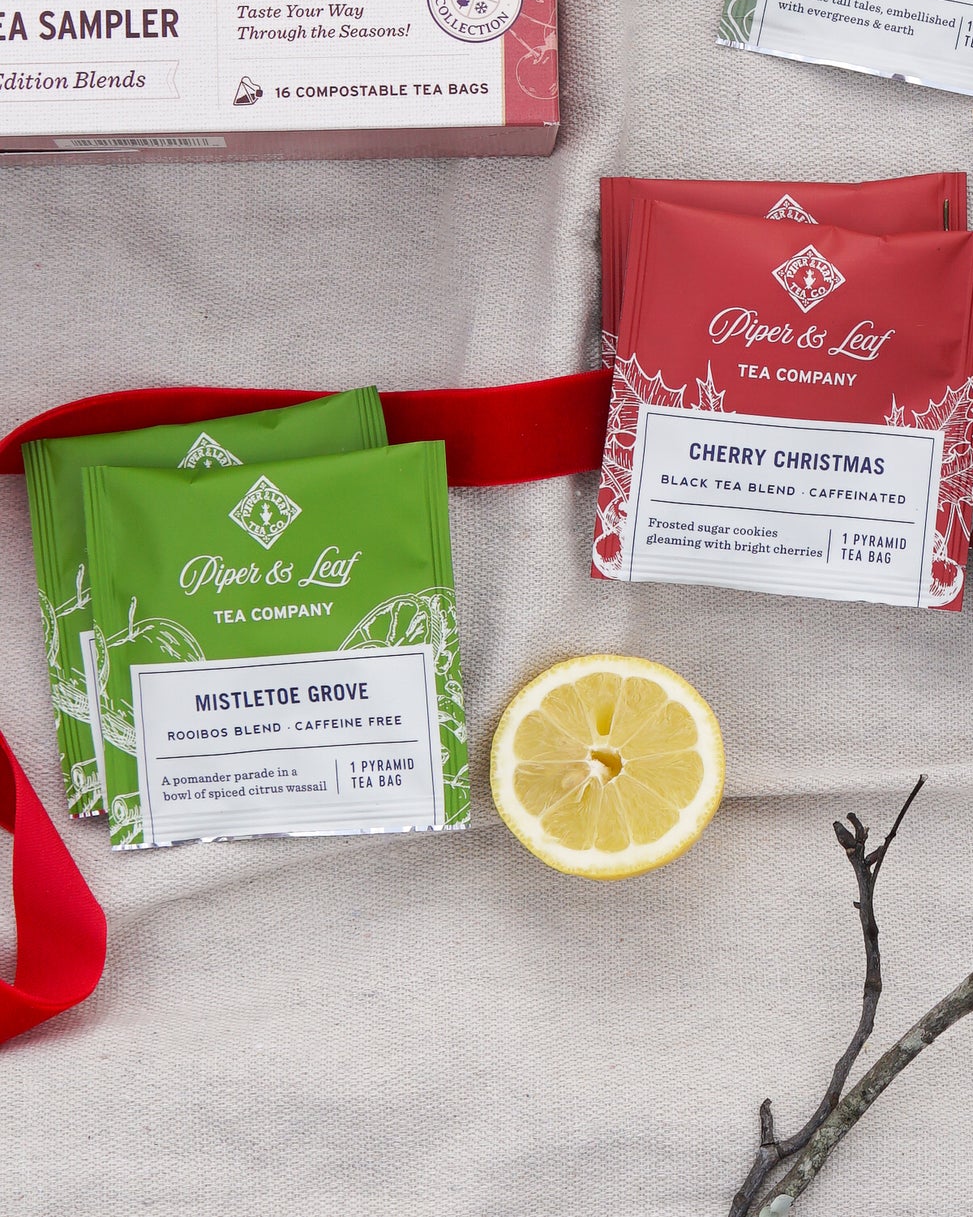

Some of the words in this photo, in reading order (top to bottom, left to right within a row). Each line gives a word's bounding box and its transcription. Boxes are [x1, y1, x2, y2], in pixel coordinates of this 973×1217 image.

[236, 4, 282, 19] Taste
[286, 4, 324, 18] Your
[328, 3, 364, 20] Way
[778, 0, 804, 14] with
[807, 7, 870, 28] evergreens
[872, 19, 882, 30] &
[884, 22, 915, 36] earth
[886, 6, 956, 28] embellished
[39, 8, 179, 40] SAMPLER
[237, 26, 308, 42] Through
[311, 24, 336, 39] the
[339, 23, 411, 38] Seasons!
[967, 20, 973, 32] 1
[73, 70, 146, 89] Blends
[275, 86, 291, 98] 16
[296, 84, 408, 98] COMPOSTABLE
[413, 84, 443, 96] TEA
[448, 82, 490, 96] BAGS
[786, 258, 808, 279] PIPER
[790, 282, 807, 298] TEA
[708, 307, 794, 348] Piper
[796, 325, 827, 349] &
[828, 320, 896, 361] Leaf
[738, 364, 770, 380] TEA
[776, 368, 858, 386] COMPANY
[689, 442, 767, 466] CHERRY
[774, 450, 885, 475] CHRISTMAS
[660, 474, 708, 488] BLACK
[715, 480, 742, 492] TEA
[748, 483, 796, 496] BLEND
[809, 488, 906, 505] CAFFEINATED
[242, 492, 263, 517] PIPER
[248, 521, 266, 535] TEA
[648, 517, 694, 532] Frosted
[697, 524, 730, 536] sugar
[733, 524, 778, 538] cookies
[646, 534, 701, 549] gleaming
[704, 538, 731, 552] with
[734, 541, 770, 554] bright
[773, 544, 823, 558] cherries
[842, 533, 848, 544] 1
[853, 534, 907, 550] PYRAMID
[840, 548, 862, 562] TEA
[868, 550, 892, 564] BAG
[179, 555, 262, 596] Piper
[265, 560, 294, 585] &
[298, 546, 362, 588] Leaf
[214, 610, 246, 624] TEA
[251, 602, 334, 622] COMPANY
[195, 687, 300, 712] MISTLETOE
[308, 682, 369, 702] GROVE
[167, 728, 228, 741] ROOIBOS
[234, 722, 281, 736] BLEND
[294, 718, 362, 731] CAFFEINE
[368, 716, 402, 727] FREE
[350, 762, 356, 773] 1
[361, 758, 415, 773] PYRAMID
[161, 776, 171, 786] A
[173, 773, 232, 787] pomander
[234, 768, 274, 783] parade
[278, 767, 290, 778] in
[291, 768, 298, 776] a
[351, 776, 373, 789] TEA
[379, 774, 402, 787] BAG
[163, 791, 192, 802] bowl
[194, 790, 207, 800] of
[208, 786, 246, 800] spiced
[248, 784, 284, 796] citrus
[286, 781, 327, 793] wassail
